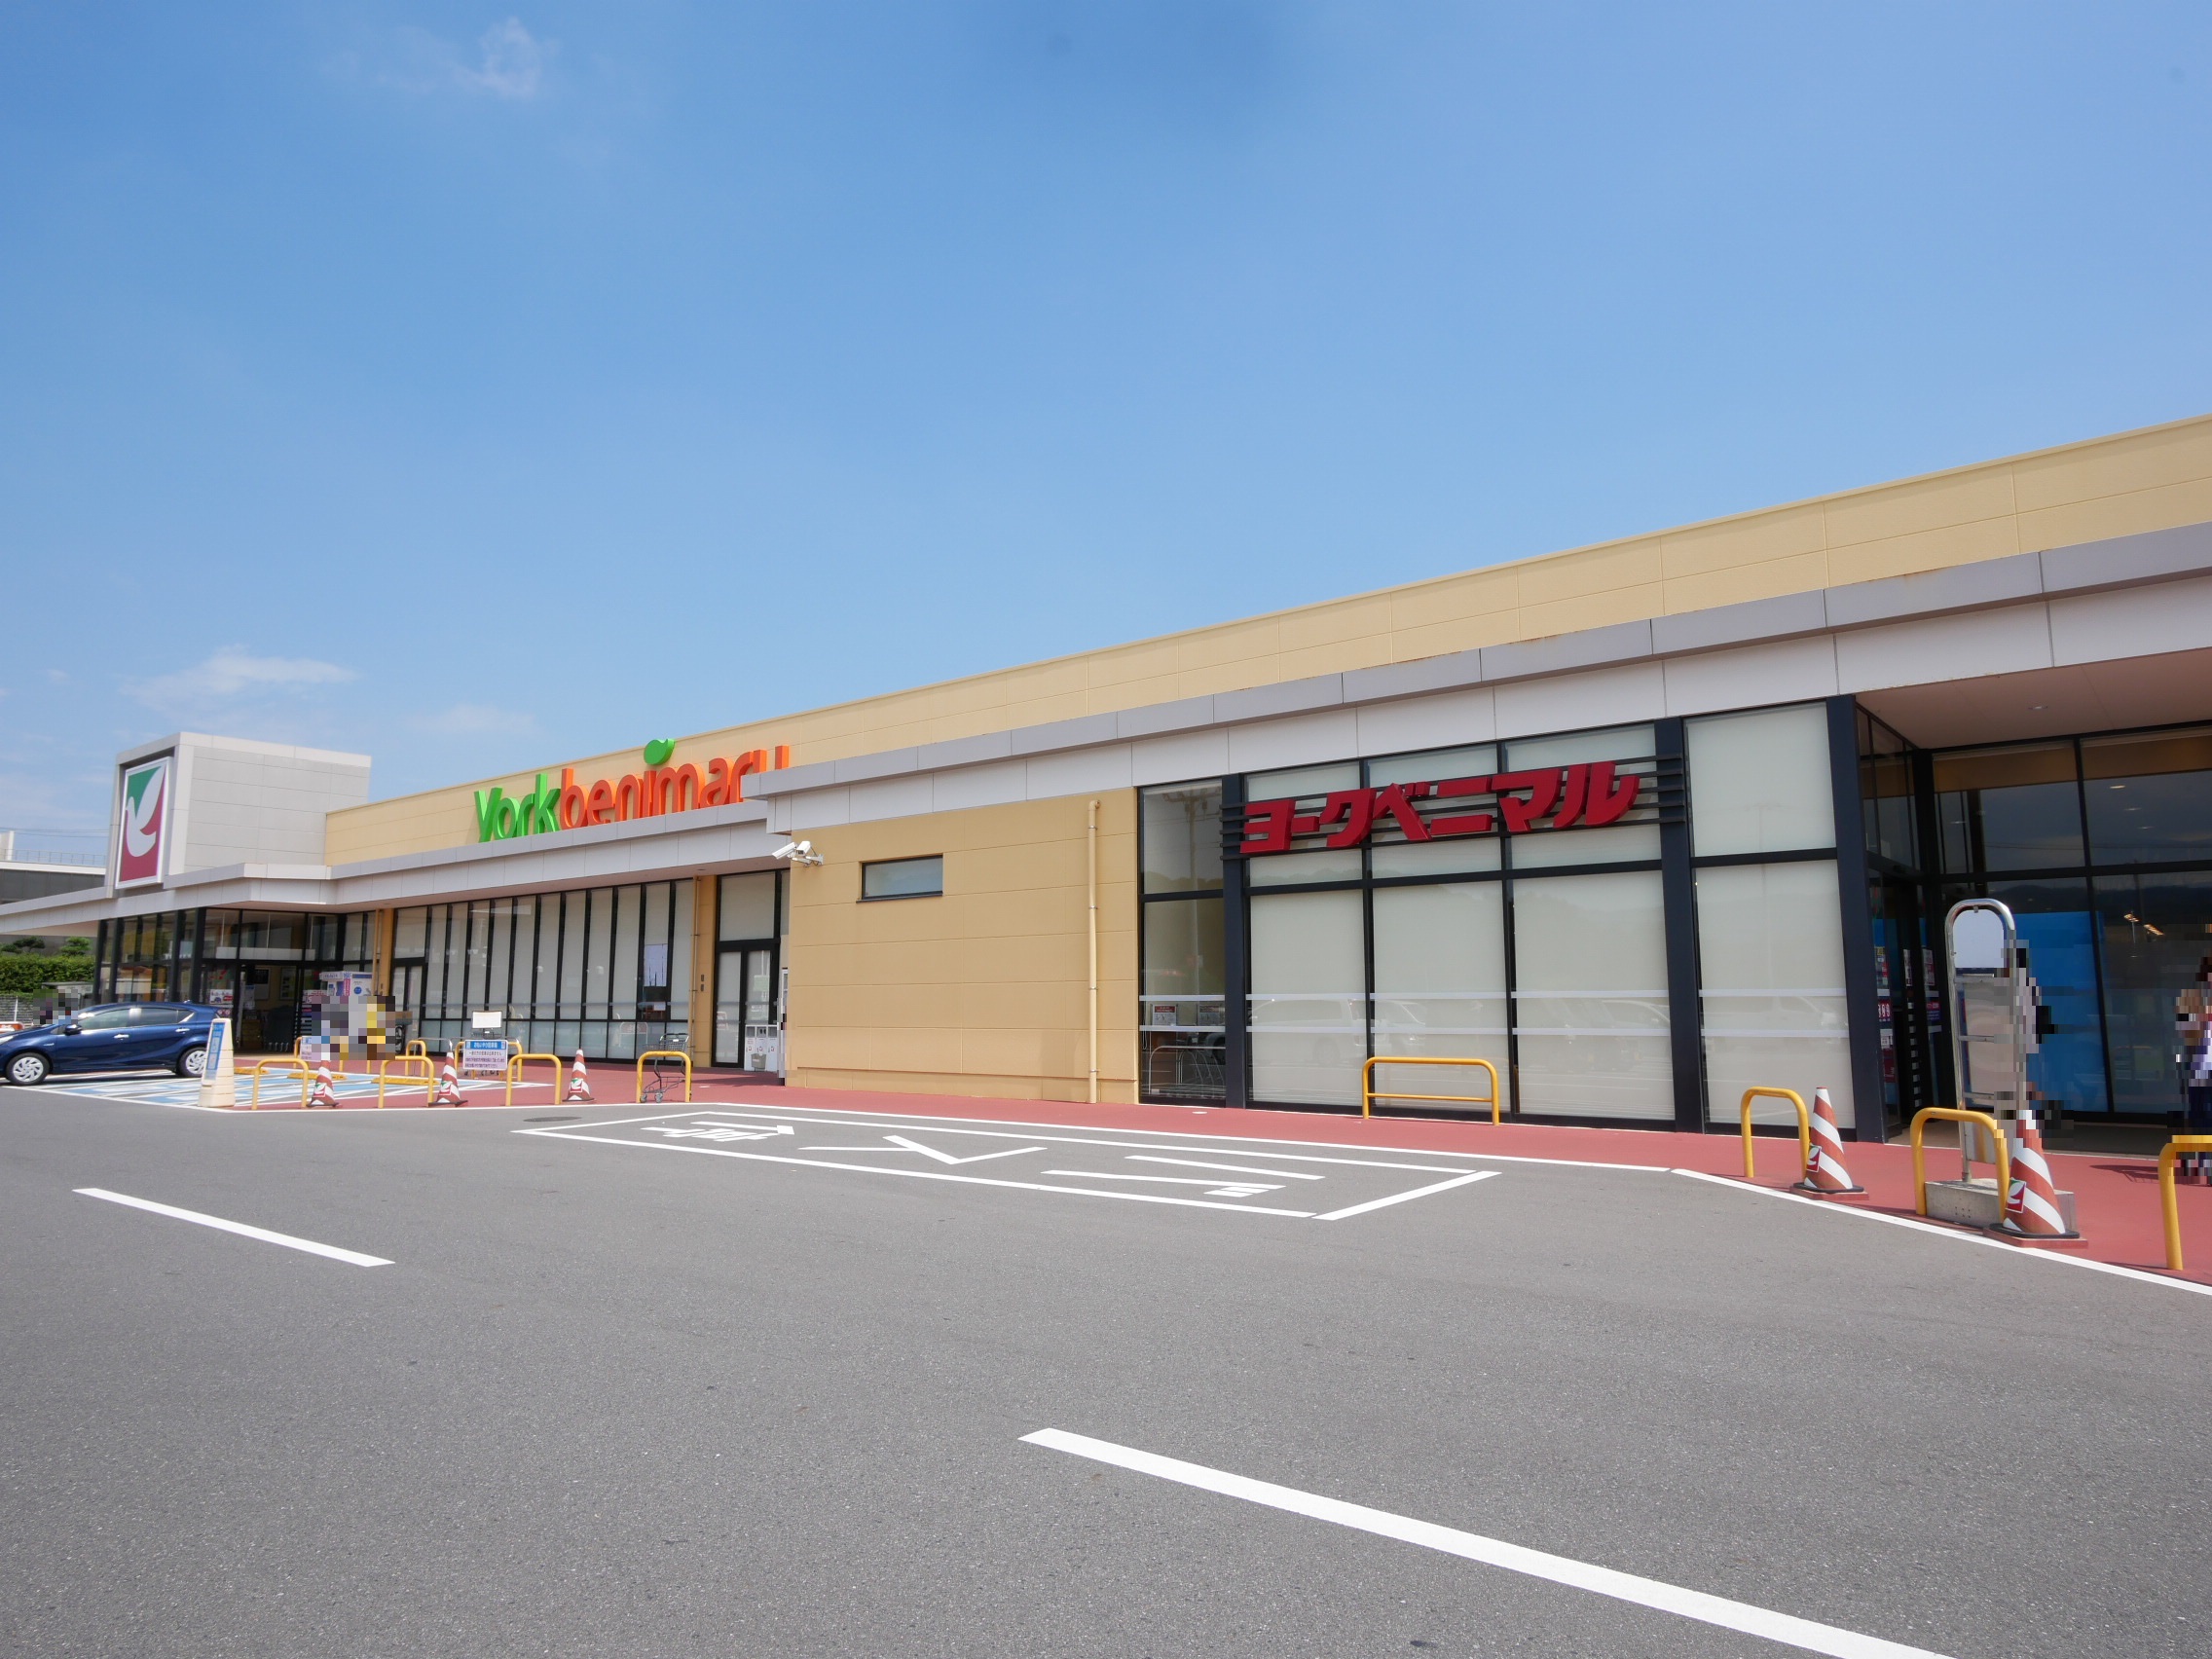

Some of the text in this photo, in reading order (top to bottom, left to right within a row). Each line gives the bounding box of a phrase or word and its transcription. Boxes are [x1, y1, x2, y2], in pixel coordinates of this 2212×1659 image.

[1239, 760, 1641, 854] ヨークベニマル
